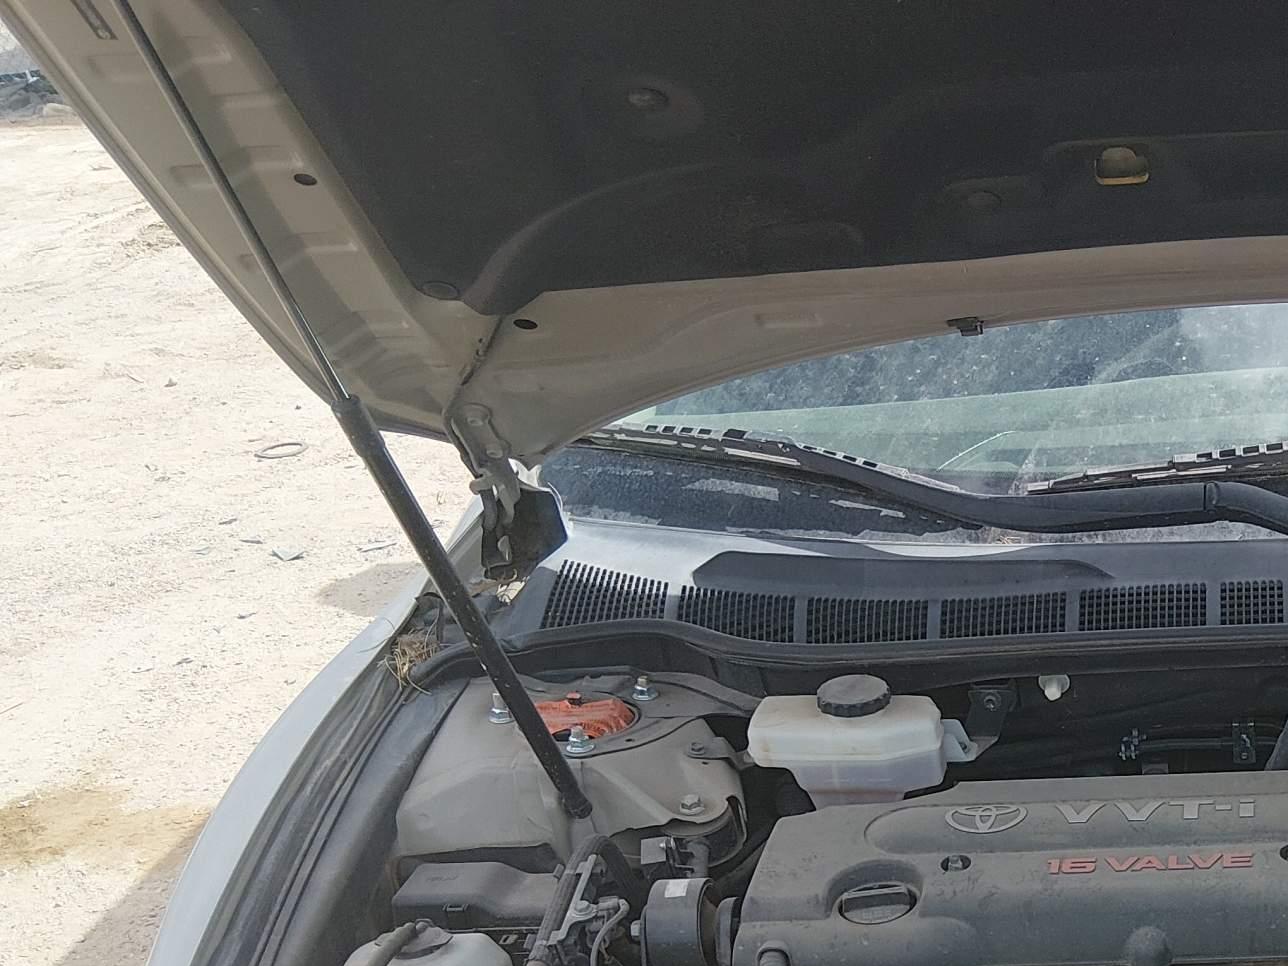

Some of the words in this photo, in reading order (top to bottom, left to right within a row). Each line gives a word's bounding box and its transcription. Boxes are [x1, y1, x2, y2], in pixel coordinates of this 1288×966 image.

[1056, 800, 1256, 824] VVT-i
[1047, 857, 1098, 875] 16
[1104, 852, 1256, 873] VALVE
